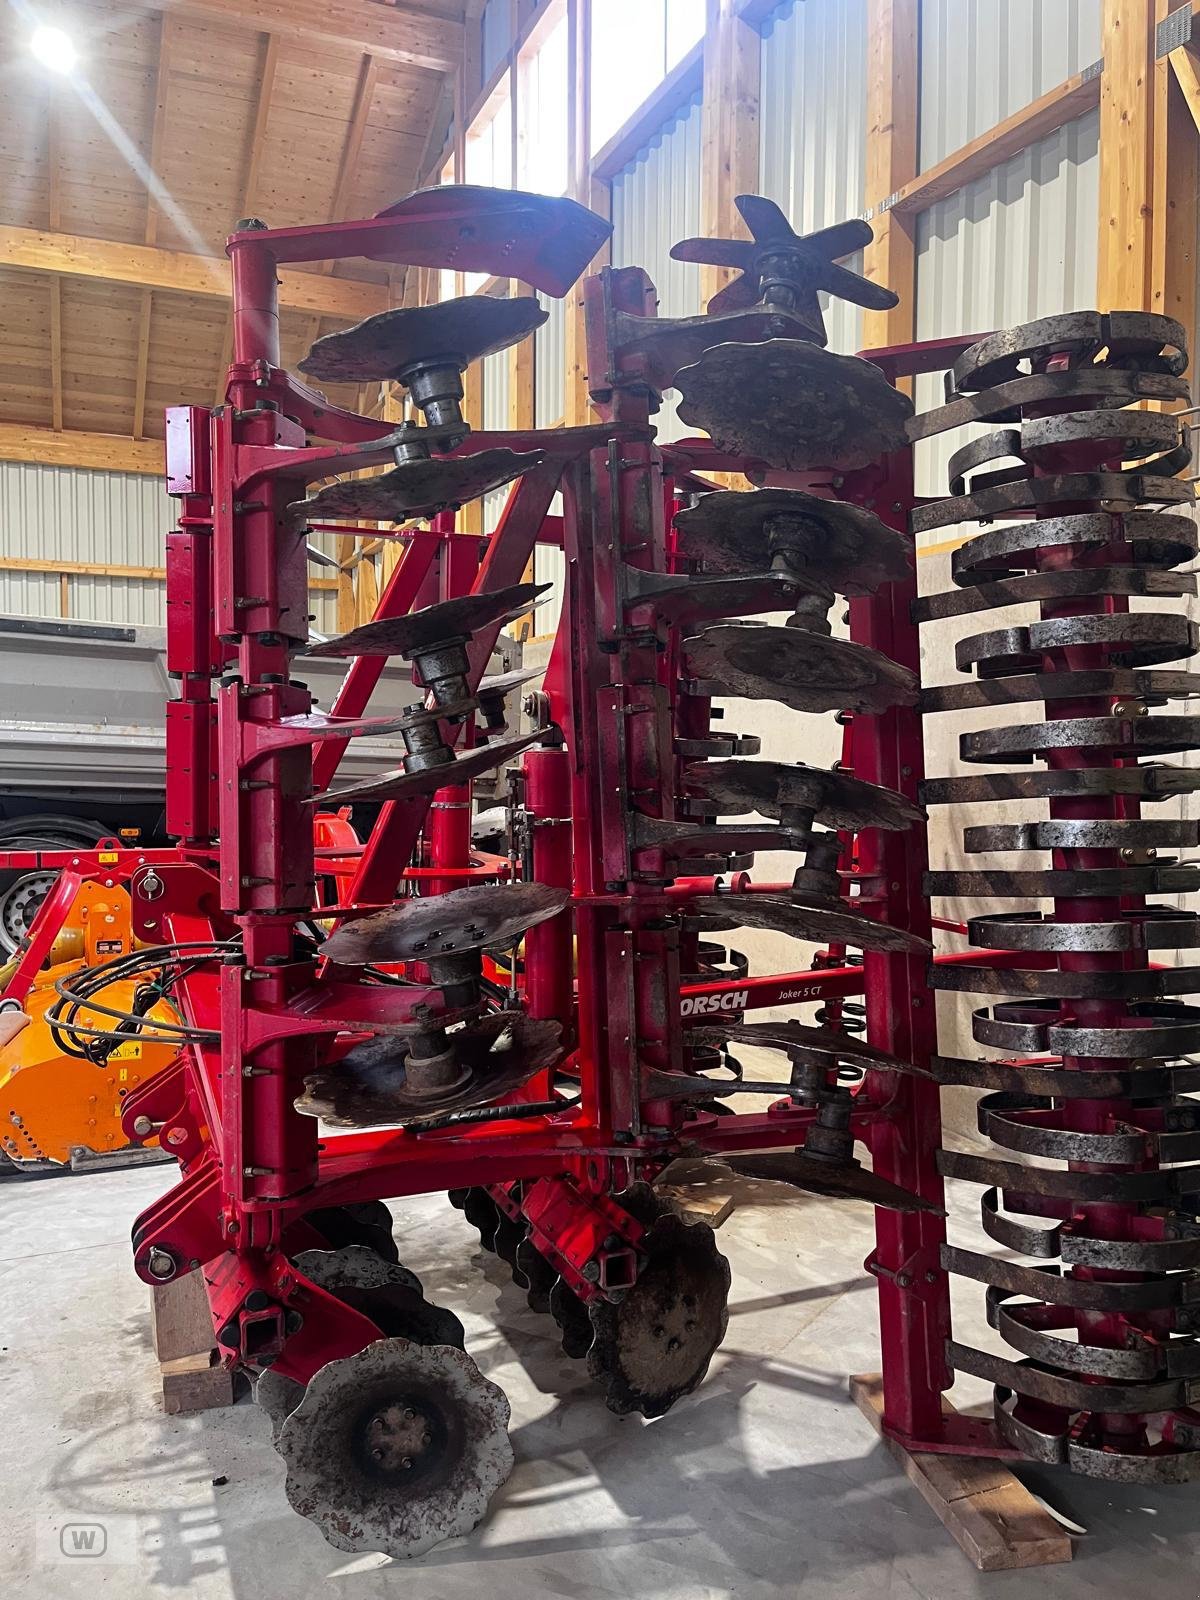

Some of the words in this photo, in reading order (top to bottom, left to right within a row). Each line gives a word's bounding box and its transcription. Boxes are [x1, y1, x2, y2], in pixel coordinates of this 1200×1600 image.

[778, 989, 802, 1000] Joker
[803, 987, 810, 997] 5
[810, 985, 822, 996] CT
[680, 990, 749, 1016] ORSCH
